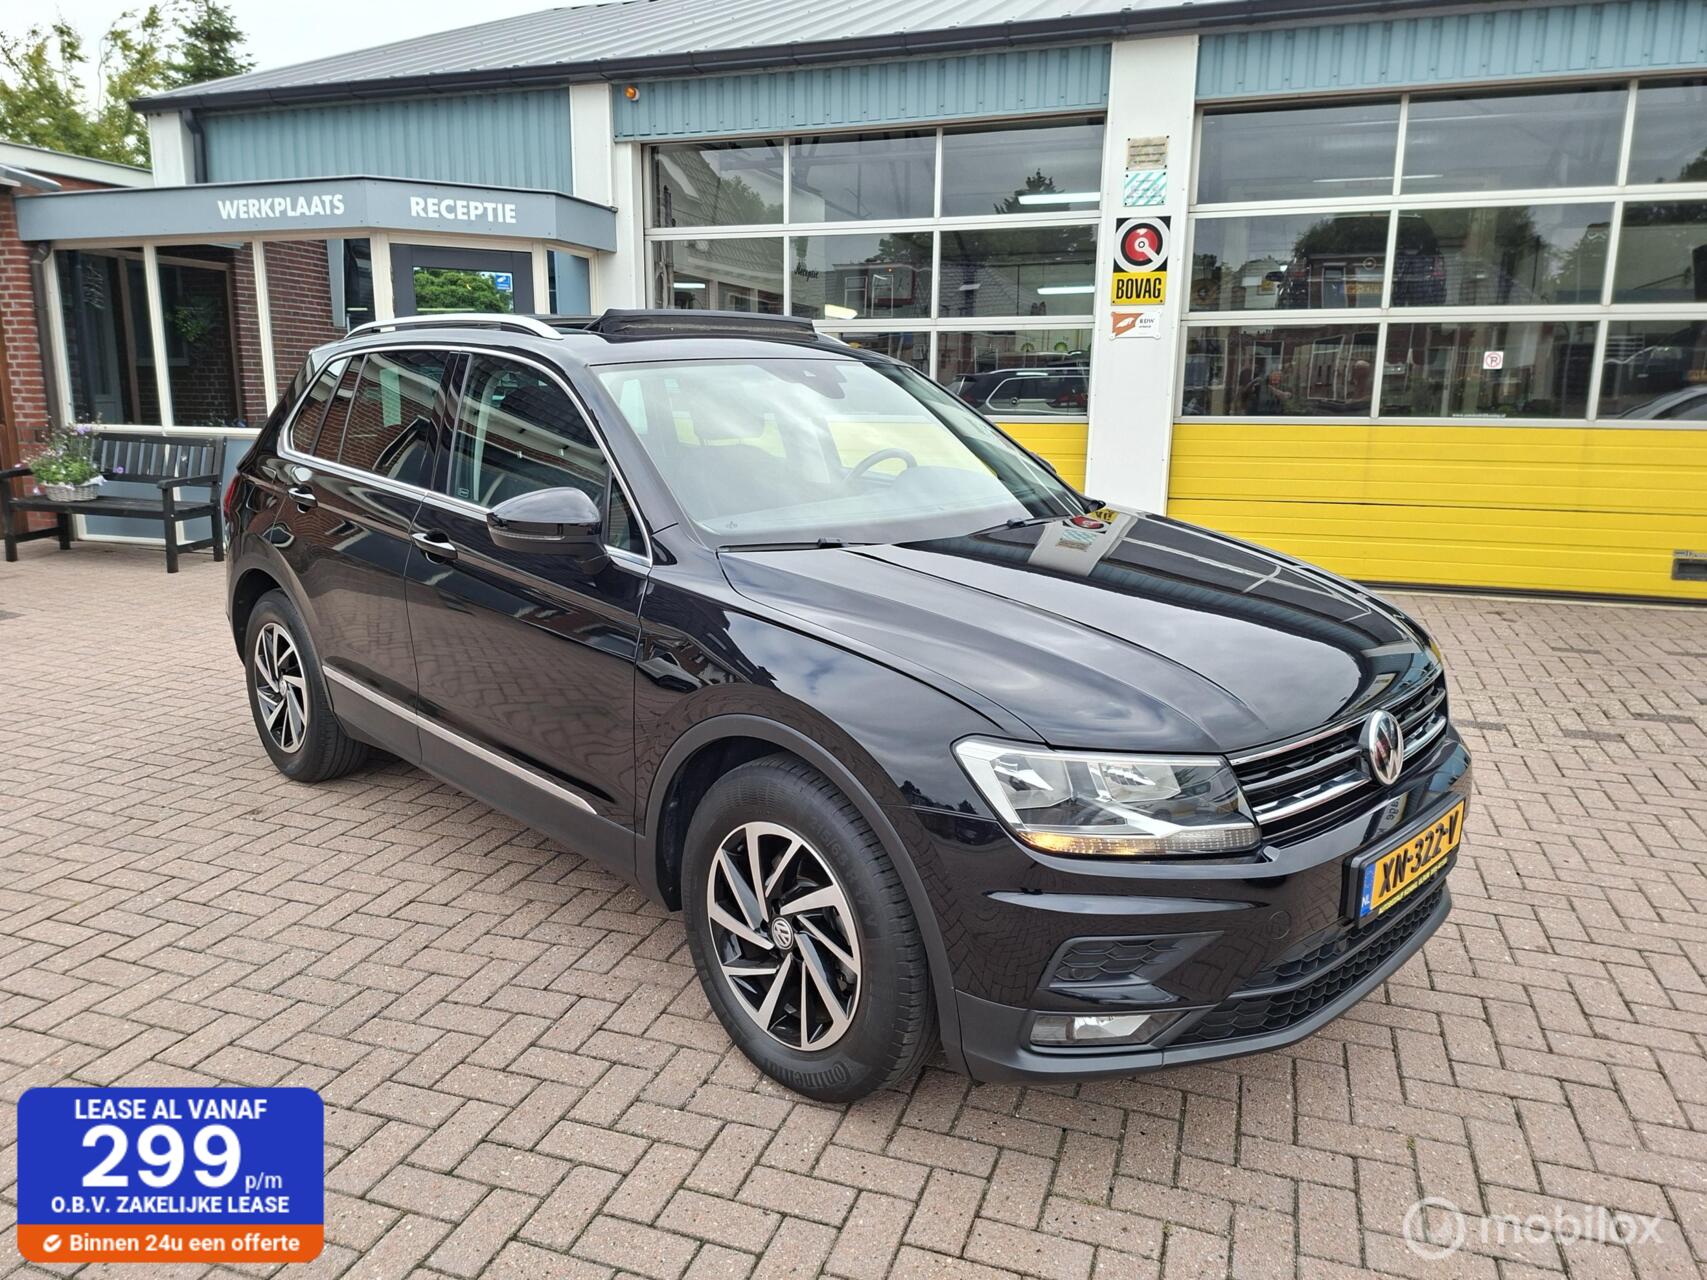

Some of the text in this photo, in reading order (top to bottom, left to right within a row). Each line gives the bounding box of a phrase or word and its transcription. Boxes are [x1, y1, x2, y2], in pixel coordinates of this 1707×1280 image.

[217, 194, 345, 220] WERKPLAATS
[410, 196, 517, 223] RECEPTIE
[1116, 277, 1162, 299] BOVAG
[1378, 810, 1460, 898] XN-322-V
